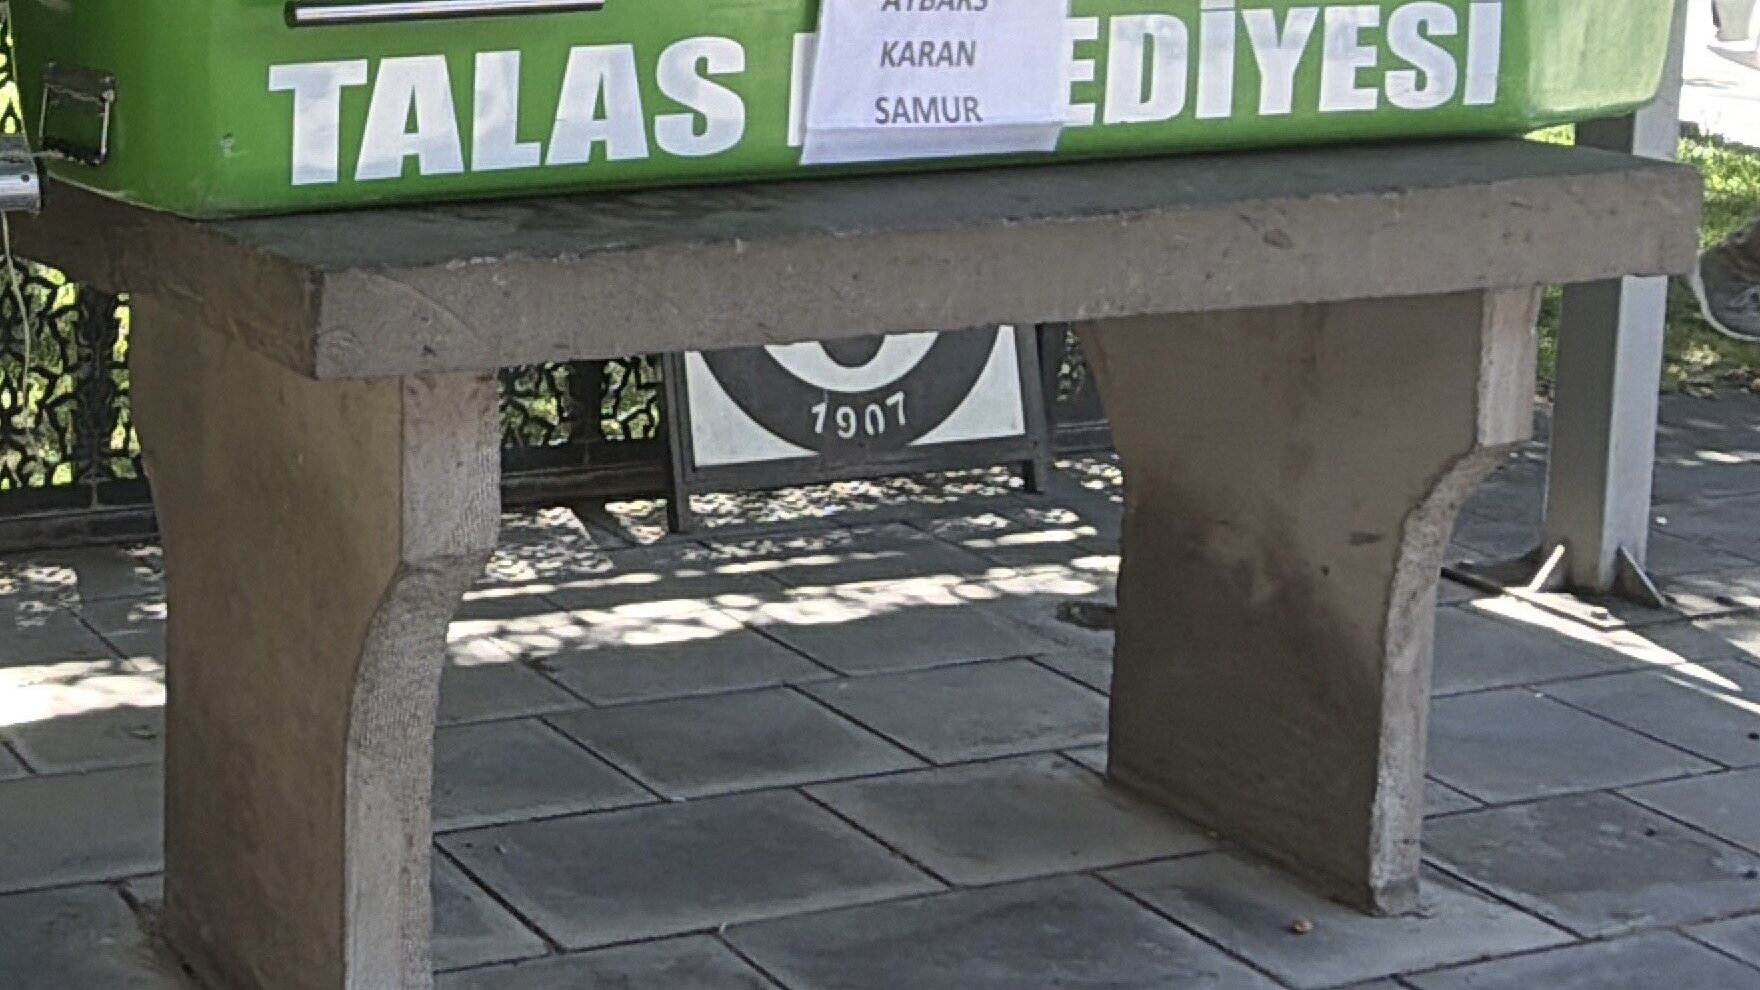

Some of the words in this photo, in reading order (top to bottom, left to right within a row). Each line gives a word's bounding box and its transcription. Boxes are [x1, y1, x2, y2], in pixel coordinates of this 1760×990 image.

[879, 40, 977, 68] KARAN
[268, 35, 746, 187] TALAS
[874, 95, 984, 125] SAMUR
[810, 390, 907, 439] 1907
